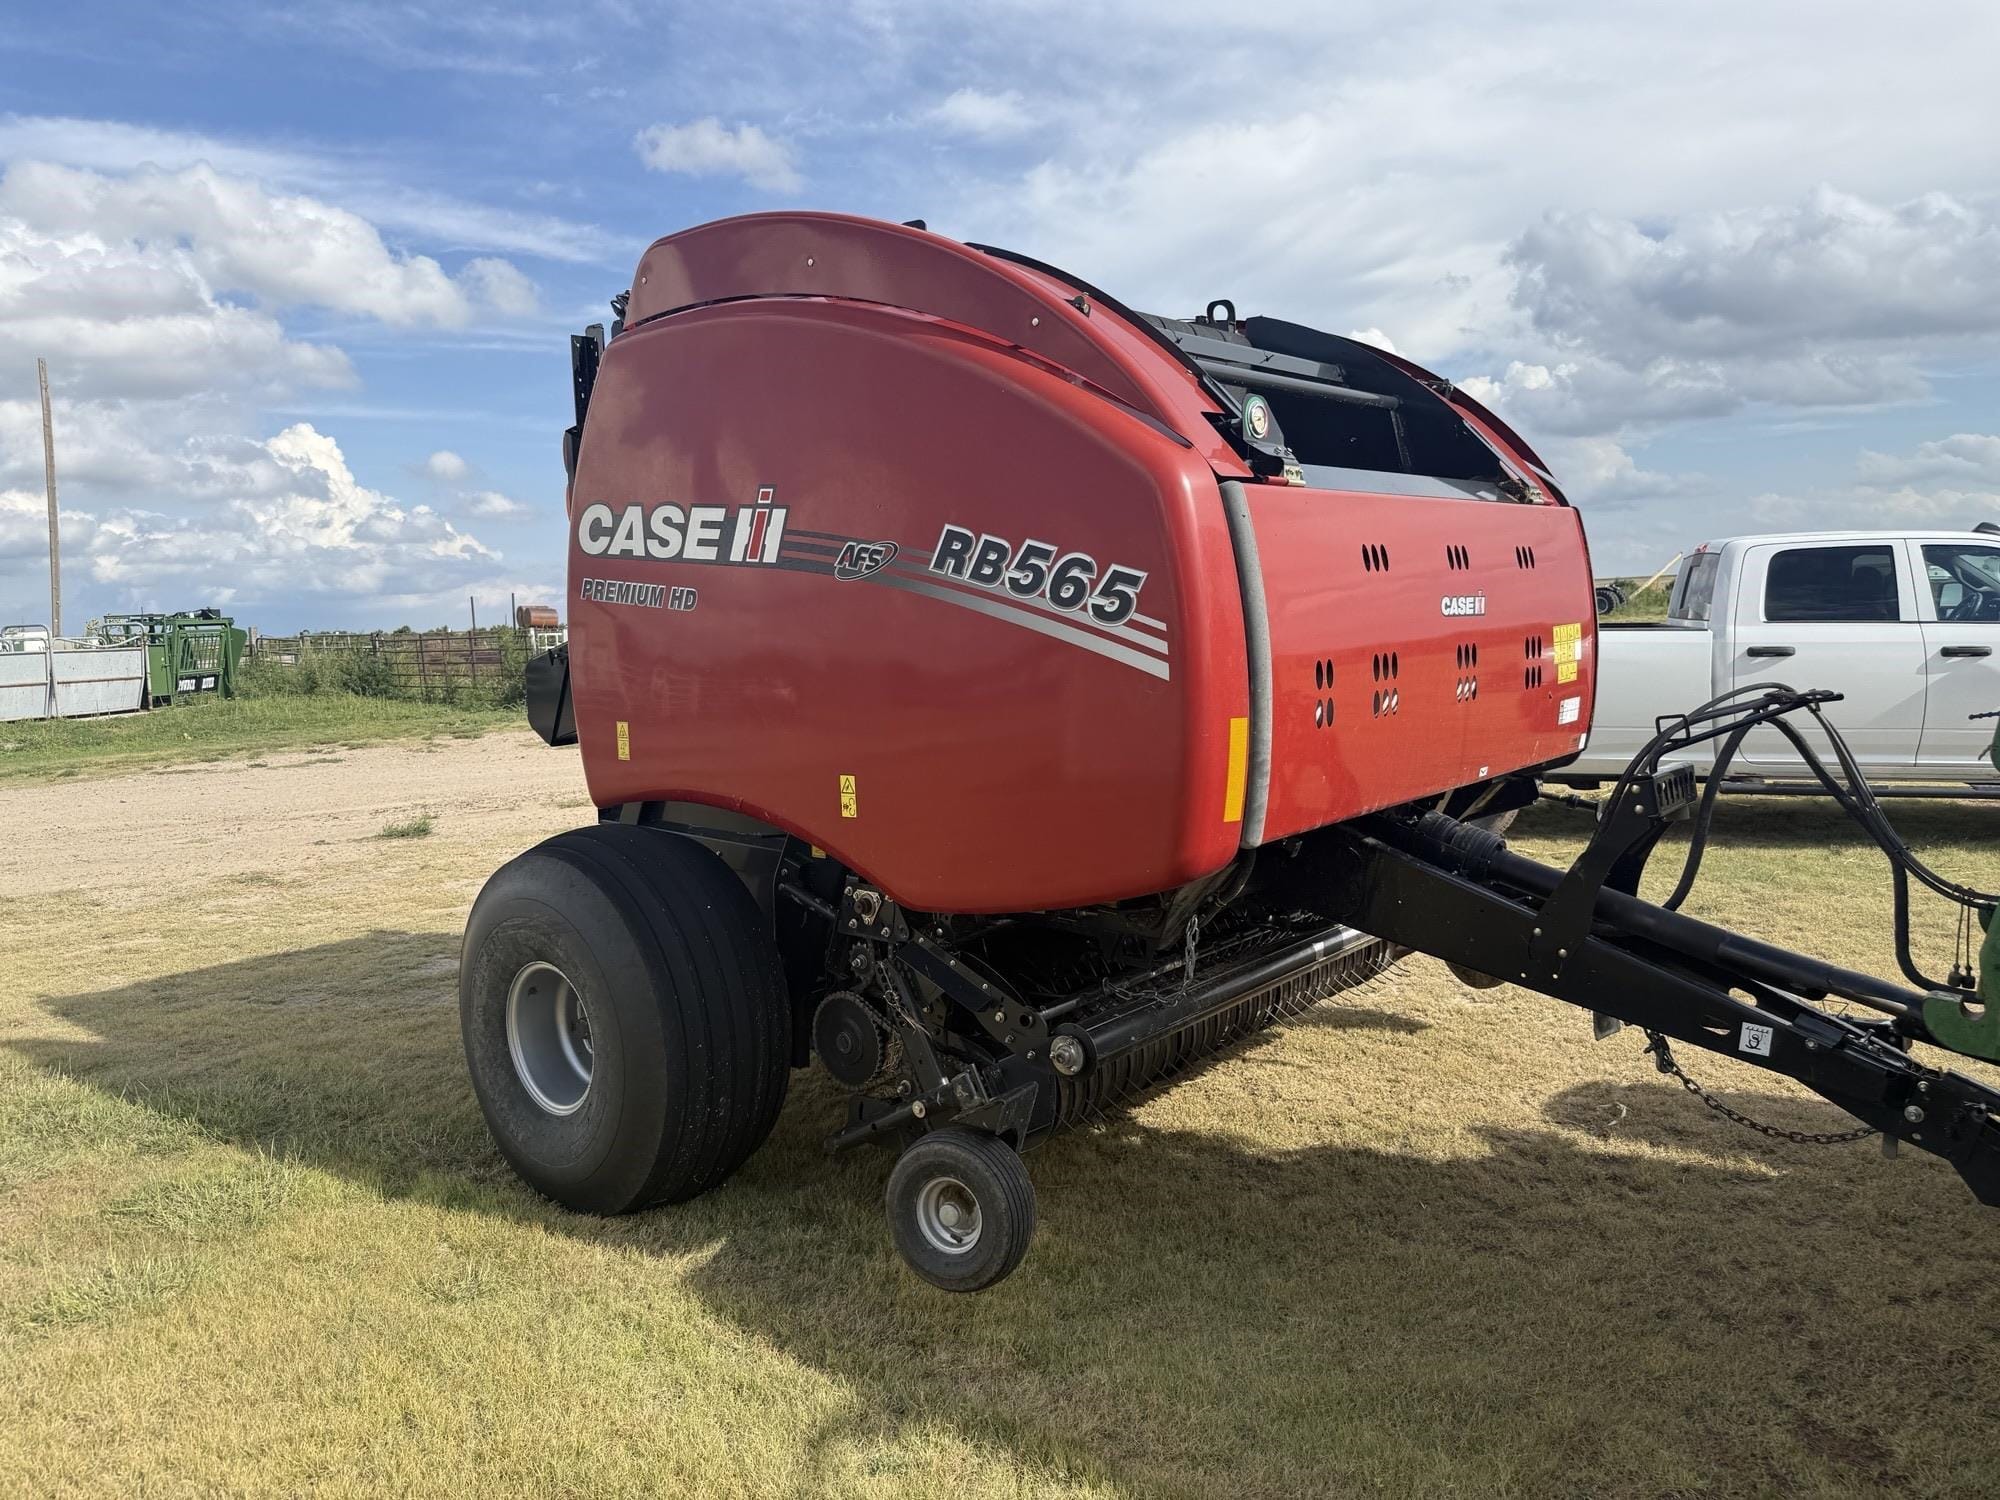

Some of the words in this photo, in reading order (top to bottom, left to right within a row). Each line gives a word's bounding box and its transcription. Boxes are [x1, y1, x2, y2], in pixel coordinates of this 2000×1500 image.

[578, 503, 727, 559] CASE
[834, 541, 885, 573] AFS
[929, 523, 1149, 627] RB565
[580, 577, 666, 609] PREMIUM
[668, 585, 699, 612] HD
[1441, 596, 1475, 616] CASE
